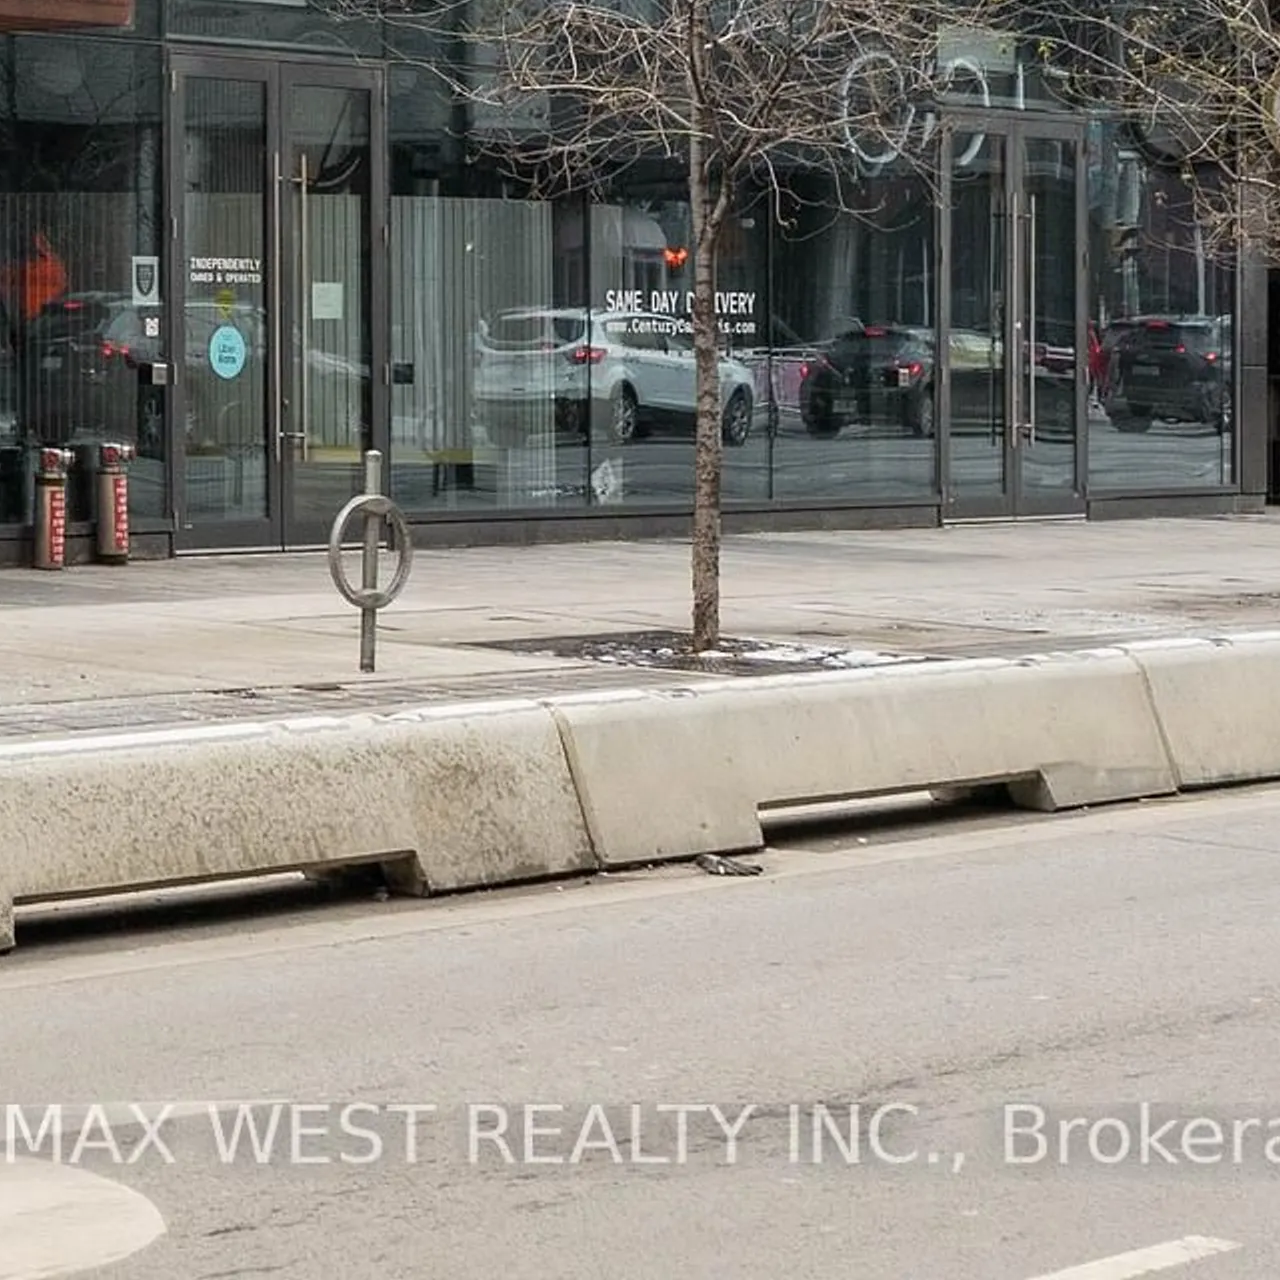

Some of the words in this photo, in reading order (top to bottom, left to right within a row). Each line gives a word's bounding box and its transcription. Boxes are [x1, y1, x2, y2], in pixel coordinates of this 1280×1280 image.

[190, 257, 261, 271] INDEPENDENTLY
[605, 290, 644, 313] SAME
[651, 290, 679, 314] DAY
[685, 291, 756, 314] DIVERY
